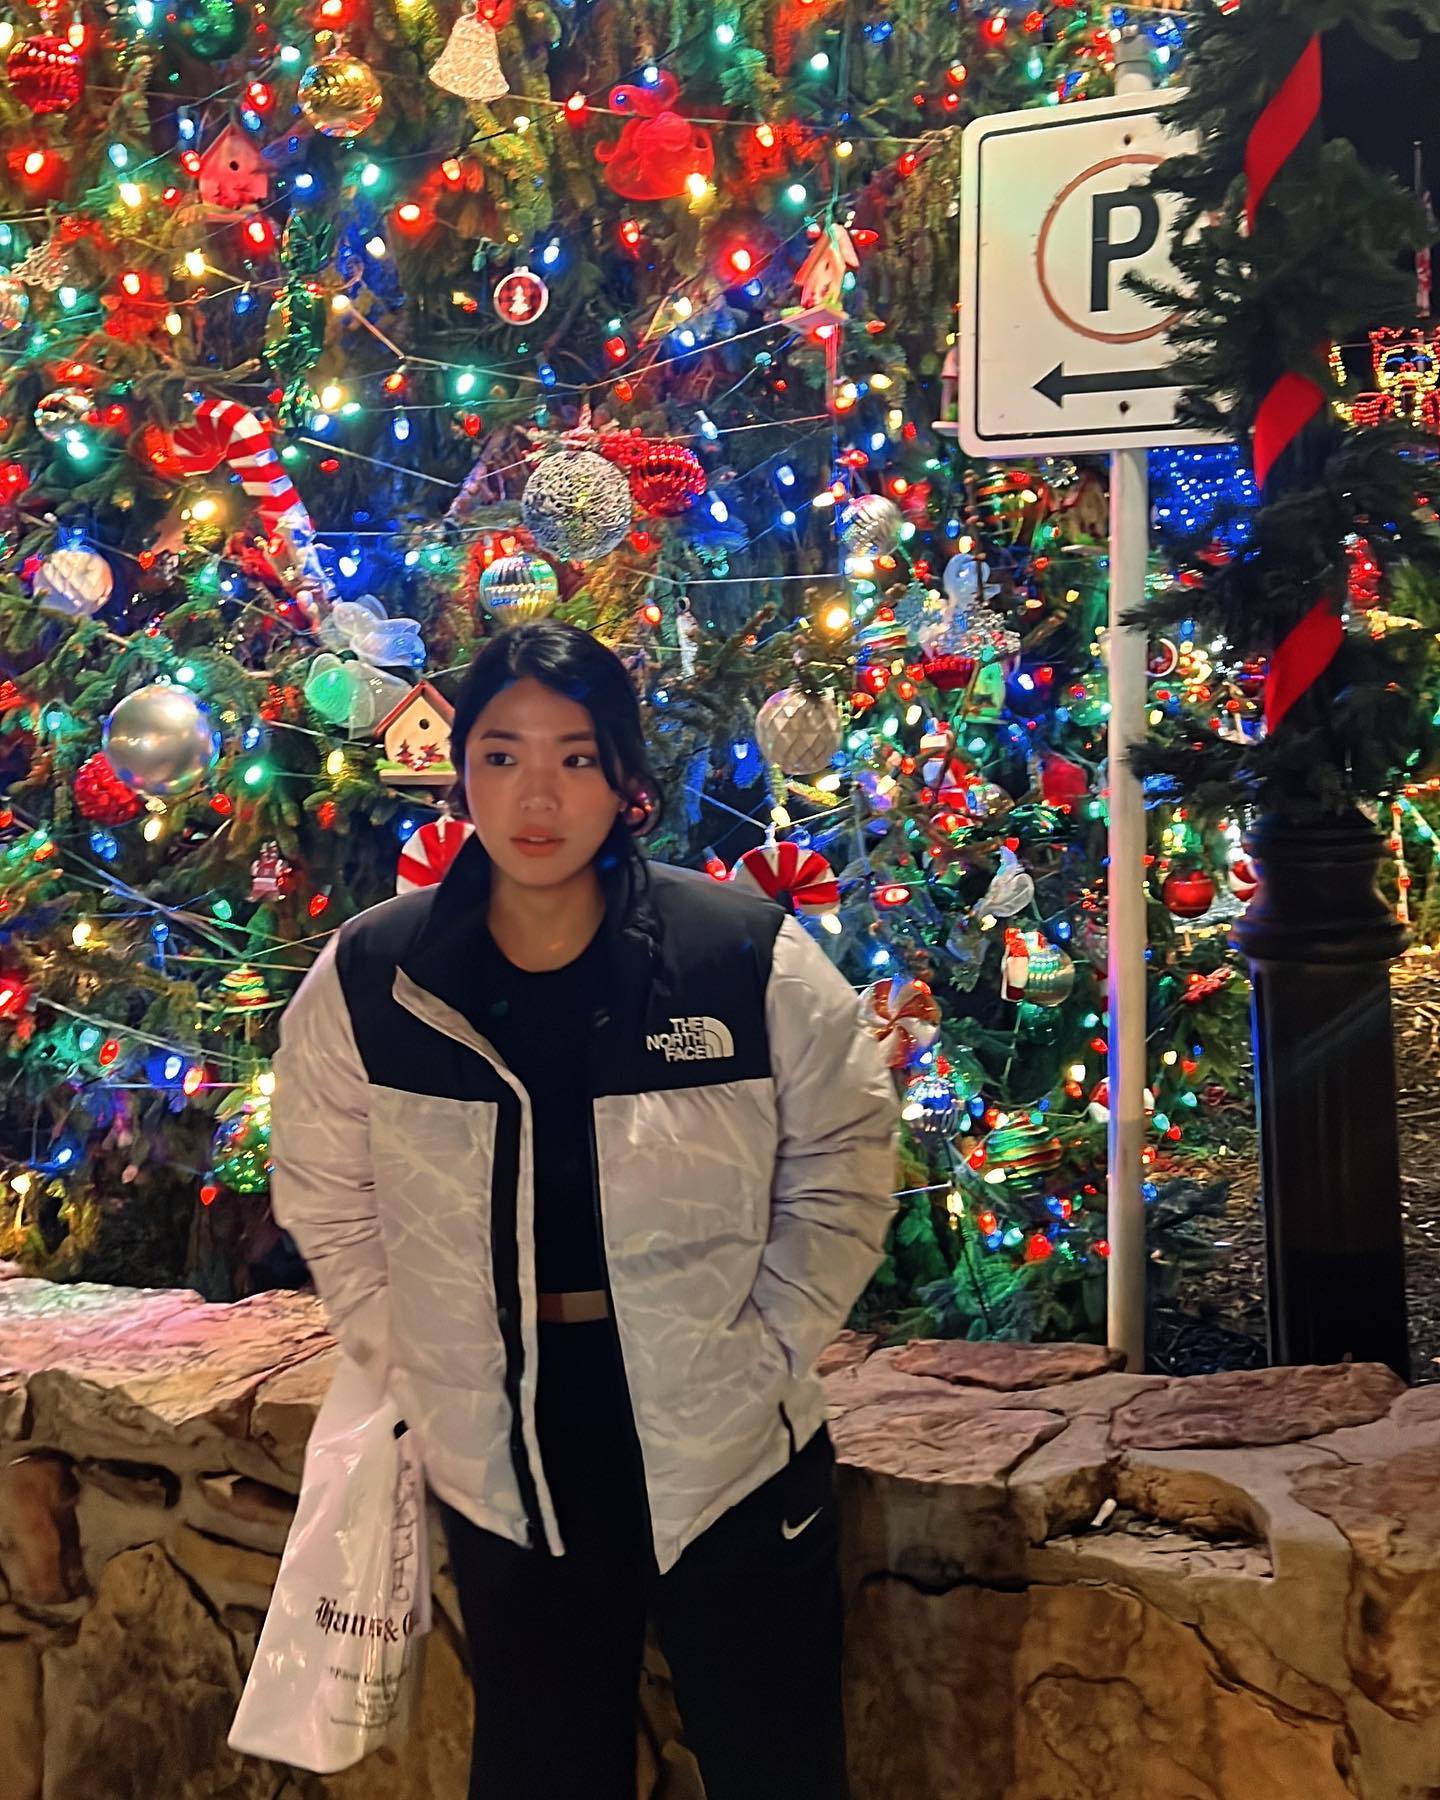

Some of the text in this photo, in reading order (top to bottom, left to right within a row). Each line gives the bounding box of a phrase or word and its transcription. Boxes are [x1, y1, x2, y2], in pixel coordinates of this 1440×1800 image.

[1091, 190, 1160, 313] P
[669, 1017, 704, 1033] THE
[646, 1031, 705, 1051] NORTH
[665, 1046, 706, 1062] FACE
